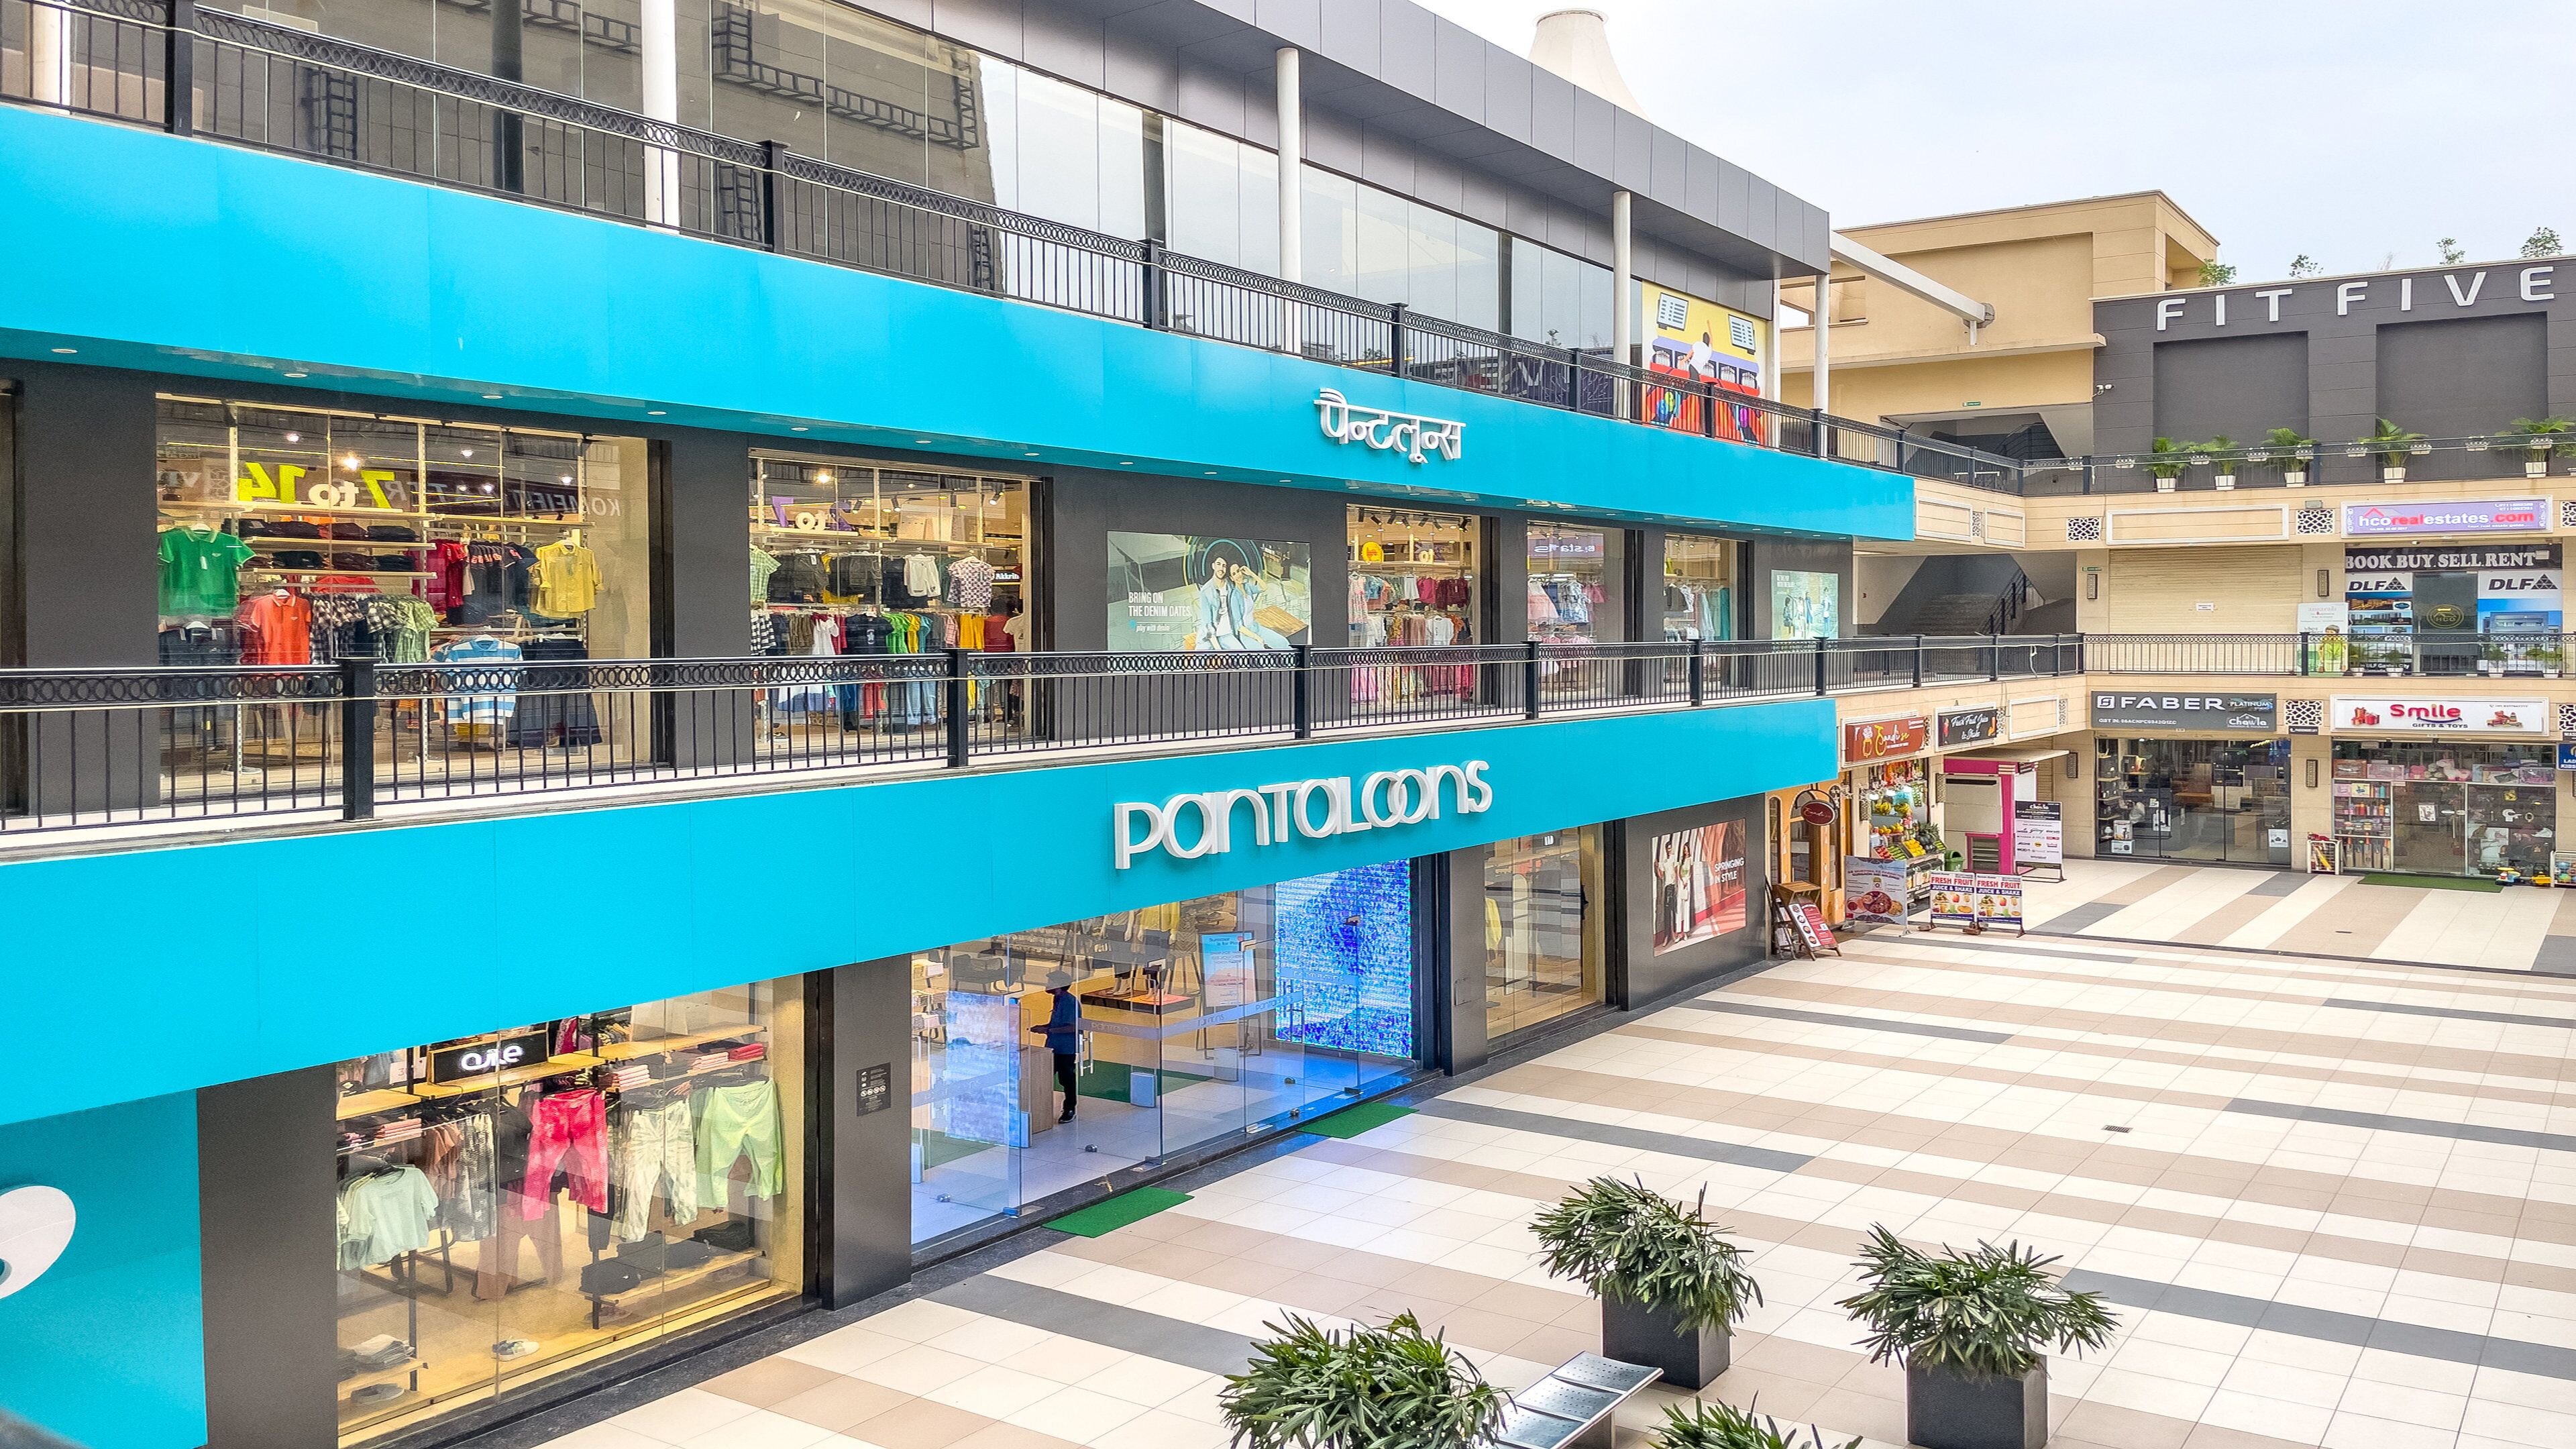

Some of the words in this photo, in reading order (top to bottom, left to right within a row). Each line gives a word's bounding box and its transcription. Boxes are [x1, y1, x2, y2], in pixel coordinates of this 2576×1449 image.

[2157, 288, 2293, 331] FIT
[2337, 266, 2555, 317] FIVE
[2349, 580, 2386, 591] DLF
[2489, 579, 2533, 591] DLF
[1128, 592, 1152, 603] BRING
[1152, 592, 1164, 603] ON
[1128, 606, 1143, 616] THE
[1144, 606, 1168, 616] DENIM
[1169, 606, 1192, 616] DATES
[2121, 696, 2226, 710] FABER
[2390, 704, 2461, 718] Smile
[1715, 857, 1745, 872] SPRINGING
[1721, 870, 1737, 883] STYLE
